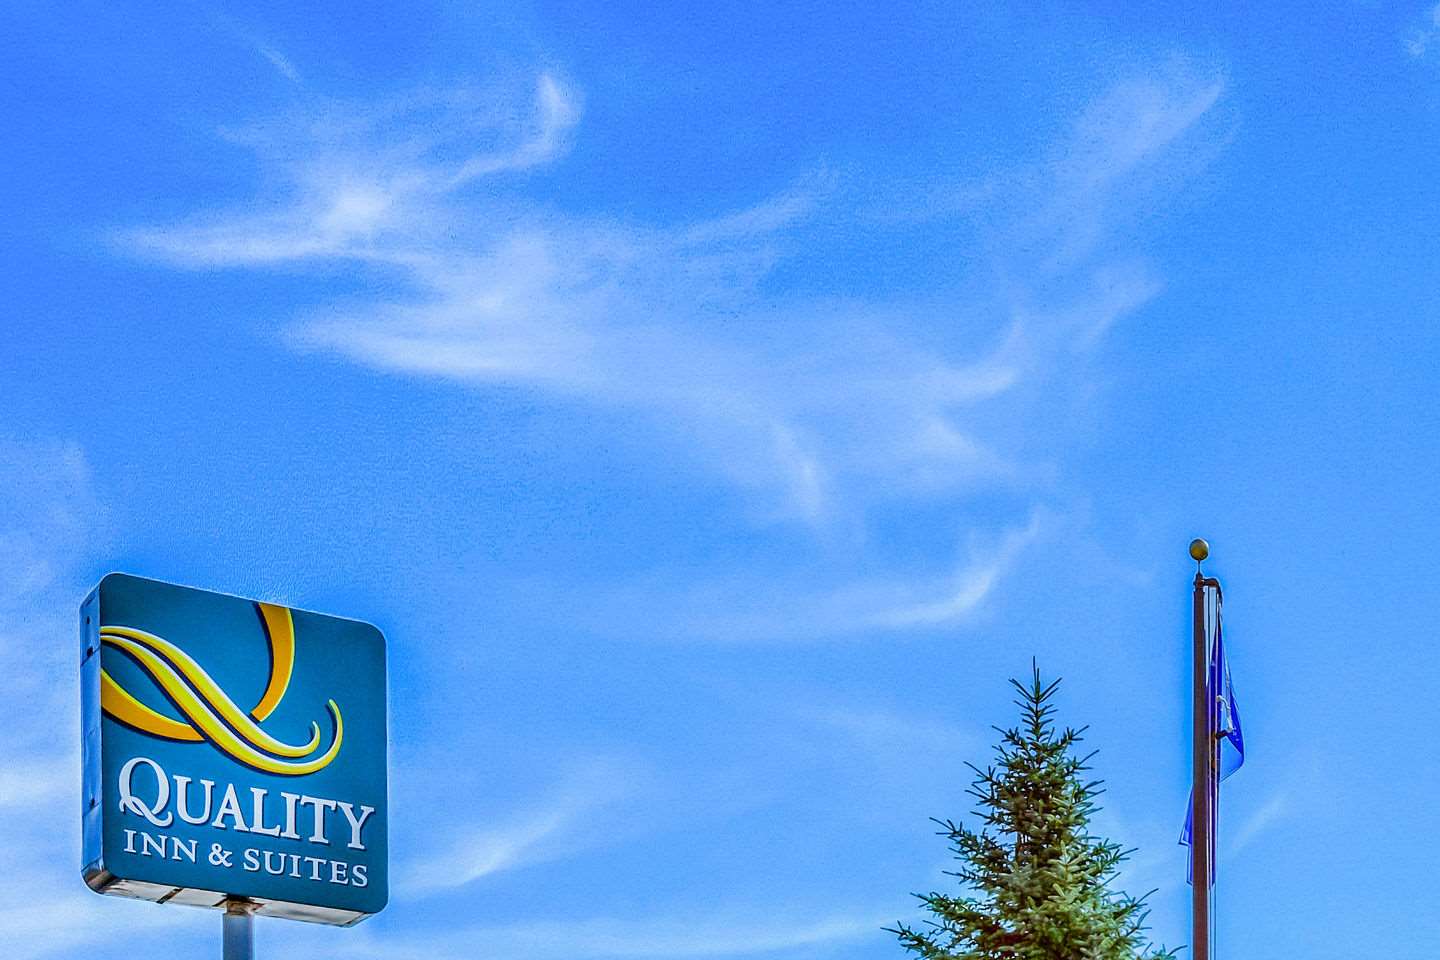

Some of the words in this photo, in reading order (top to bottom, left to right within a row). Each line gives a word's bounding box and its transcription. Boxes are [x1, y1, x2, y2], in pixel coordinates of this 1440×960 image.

[118, 757, 375, 850] QUALITY
[123, 829, 198, 863] INN
[209, 842, 233, 868] &
[243, 848, 369, 888] SUITES
